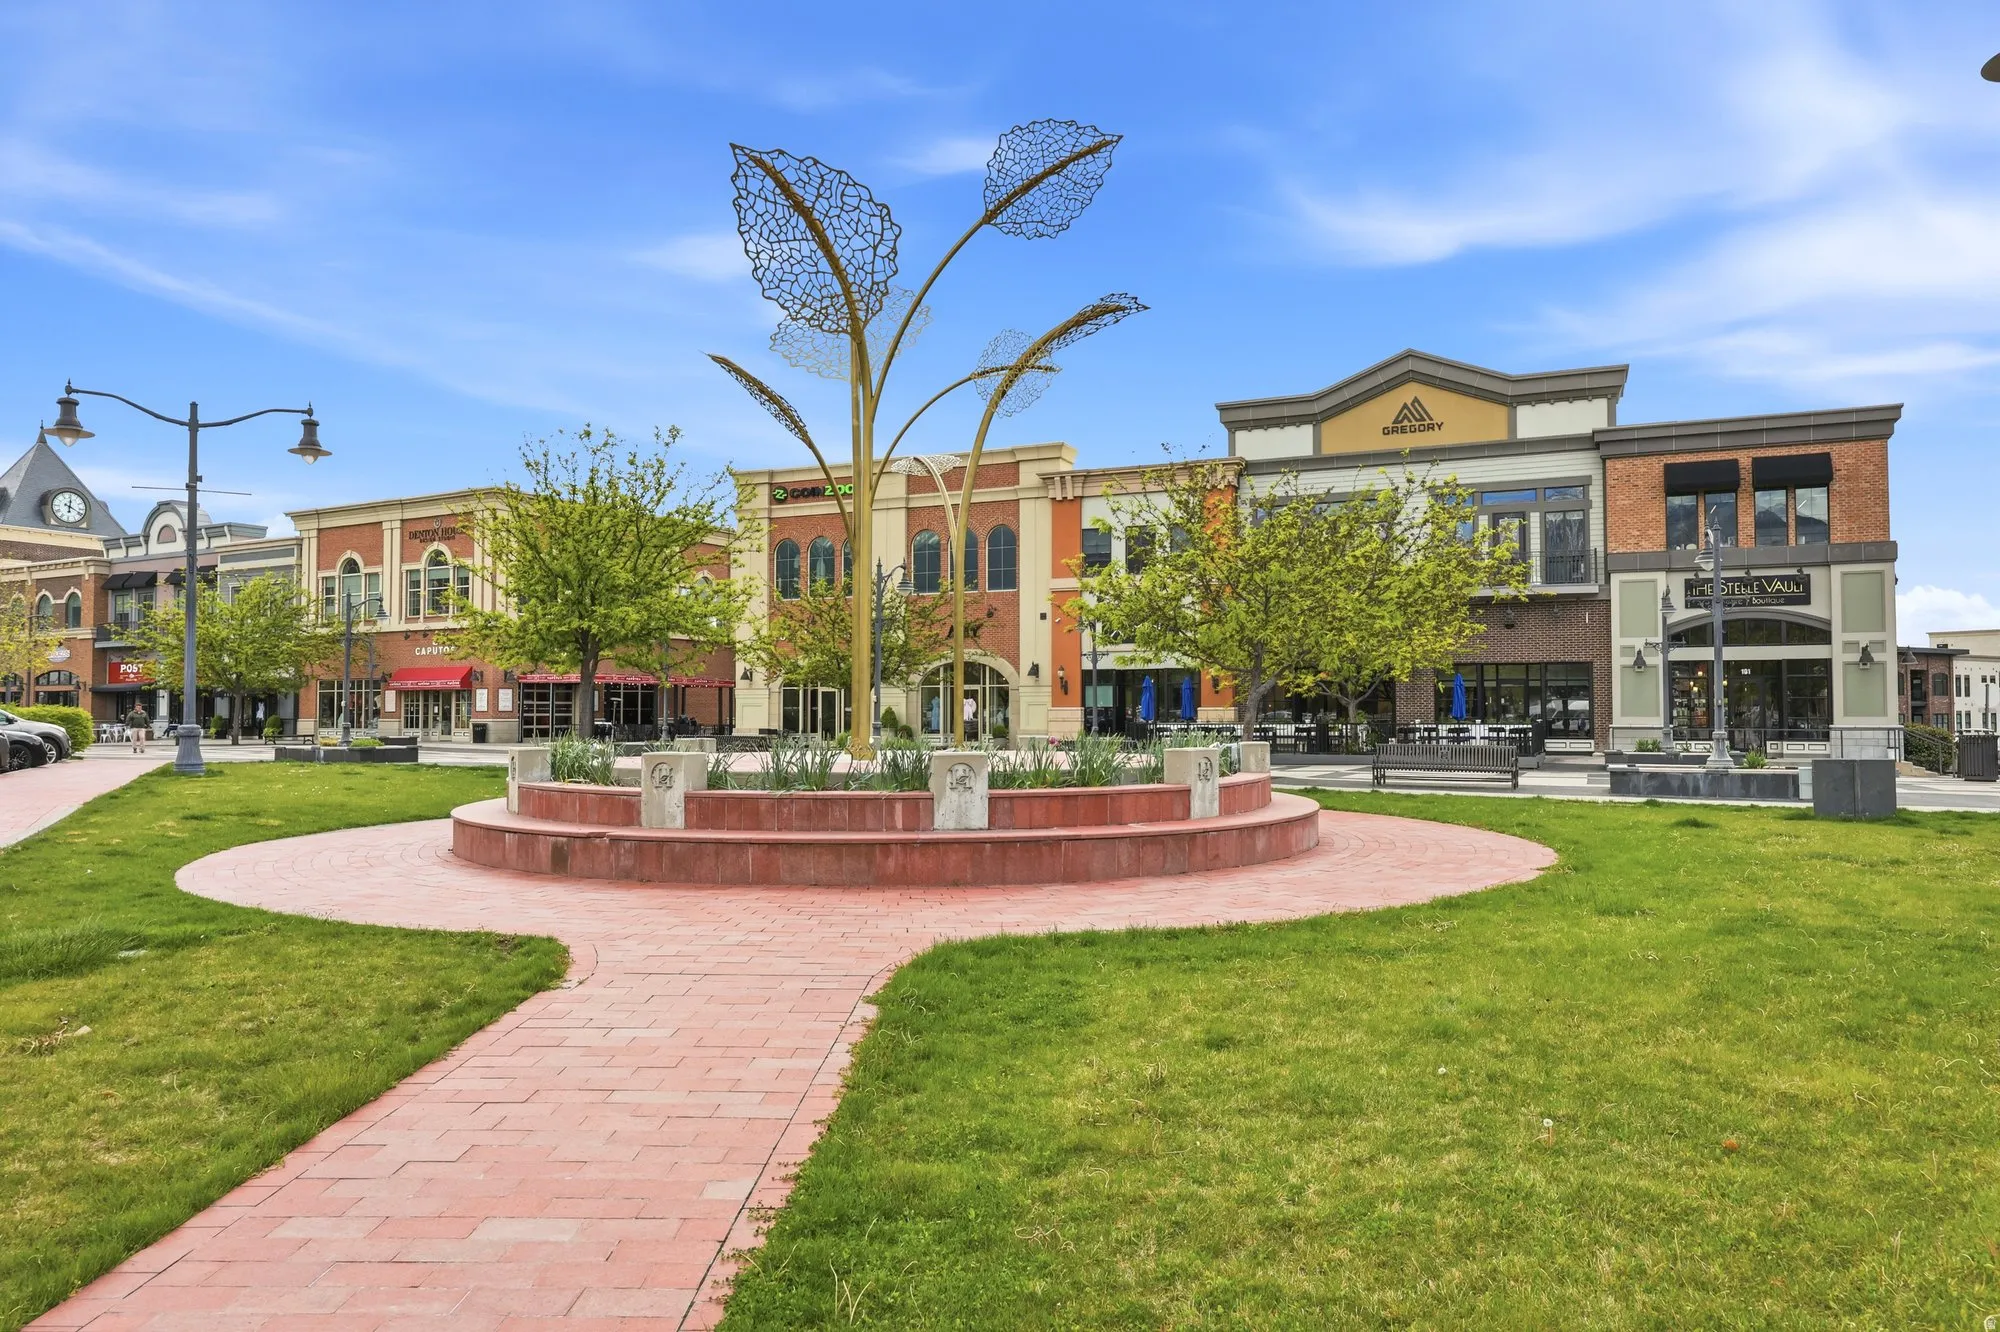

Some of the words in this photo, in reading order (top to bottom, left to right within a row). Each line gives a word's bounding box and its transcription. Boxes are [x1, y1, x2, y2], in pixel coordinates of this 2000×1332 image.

[1382, 422, 1444, 435] GREGORY
[408, 528, 439, 540] DENTON
[441, 526, 464, 536] HOU
[1761, 578, 1803, 593] VAULT
[1752, 597, 1785, 605] boutique
[120, 664, 144, 673] POST
